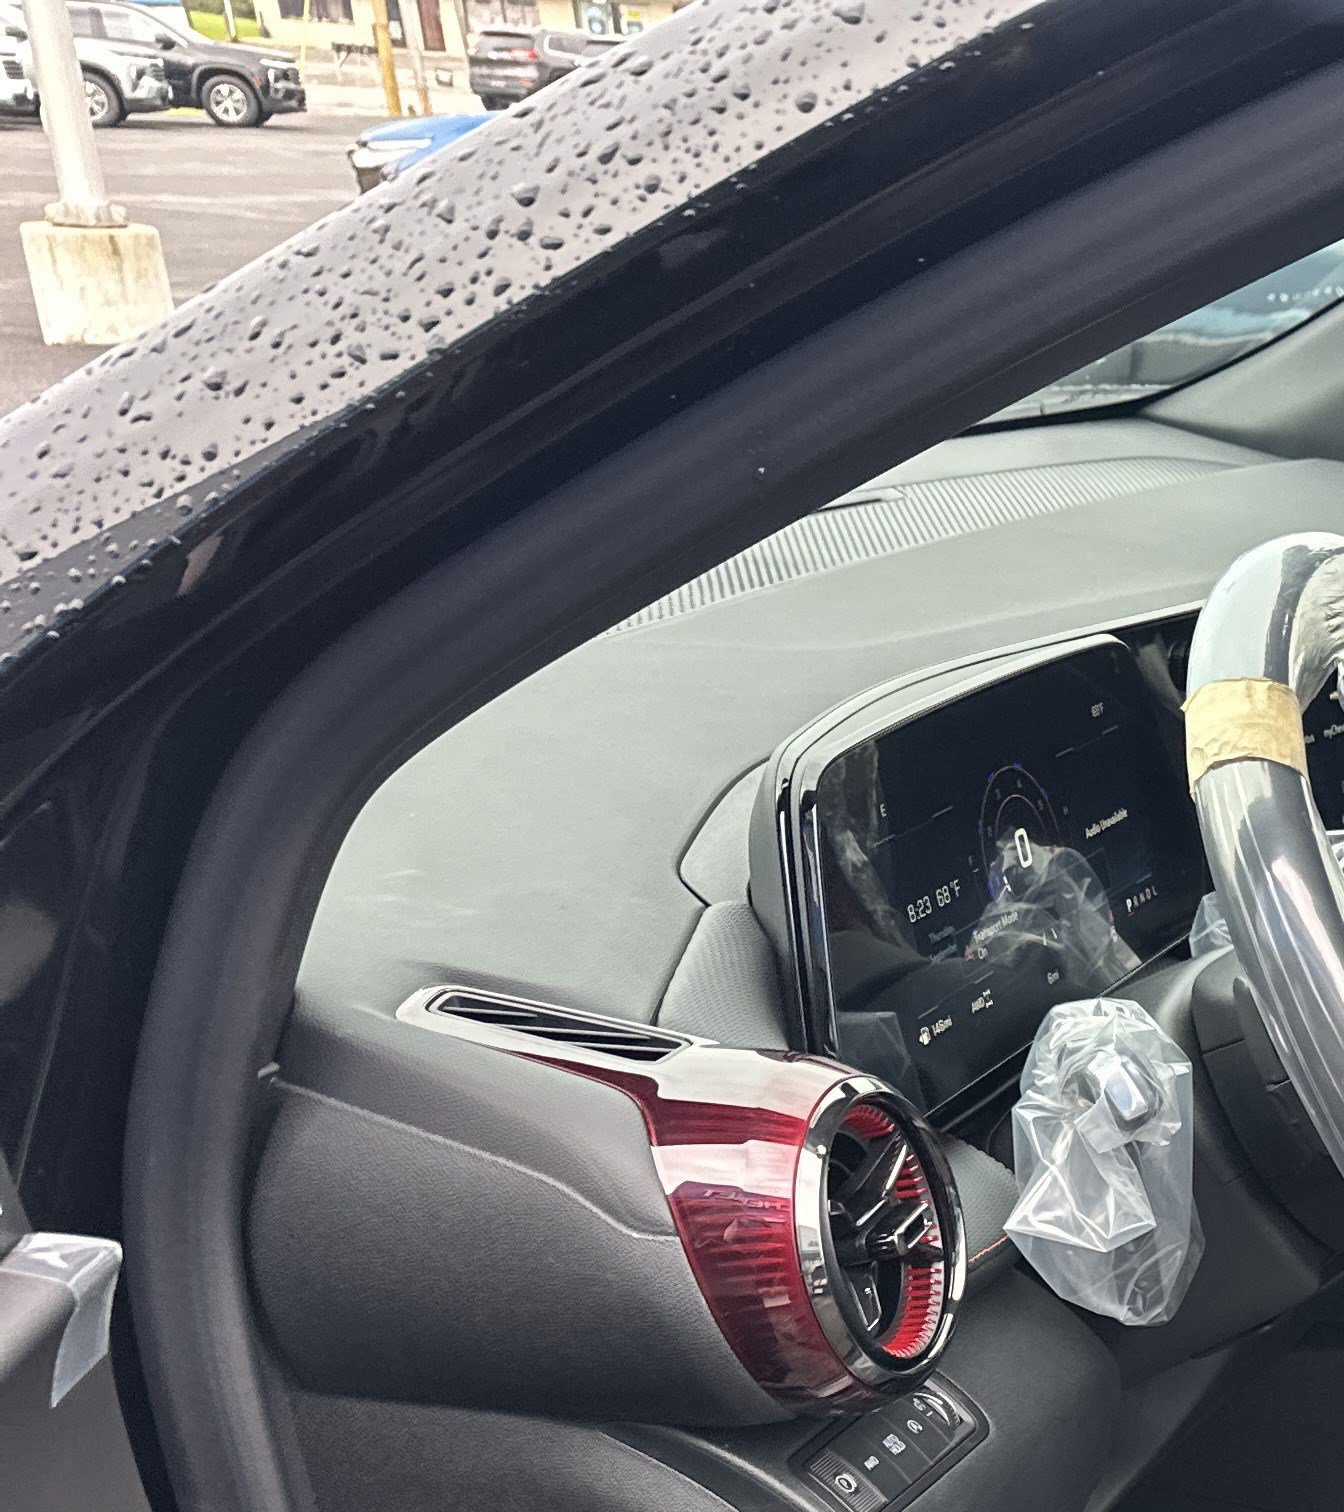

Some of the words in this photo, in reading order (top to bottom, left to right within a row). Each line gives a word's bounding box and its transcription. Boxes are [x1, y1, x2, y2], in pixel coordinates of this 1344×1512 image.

[1014, 827, 1033, 869] 0
[906, 894, 932, 923] 8:23
[936, 878, 961, 908] 68°F
[977, 947, 988, 960] On
